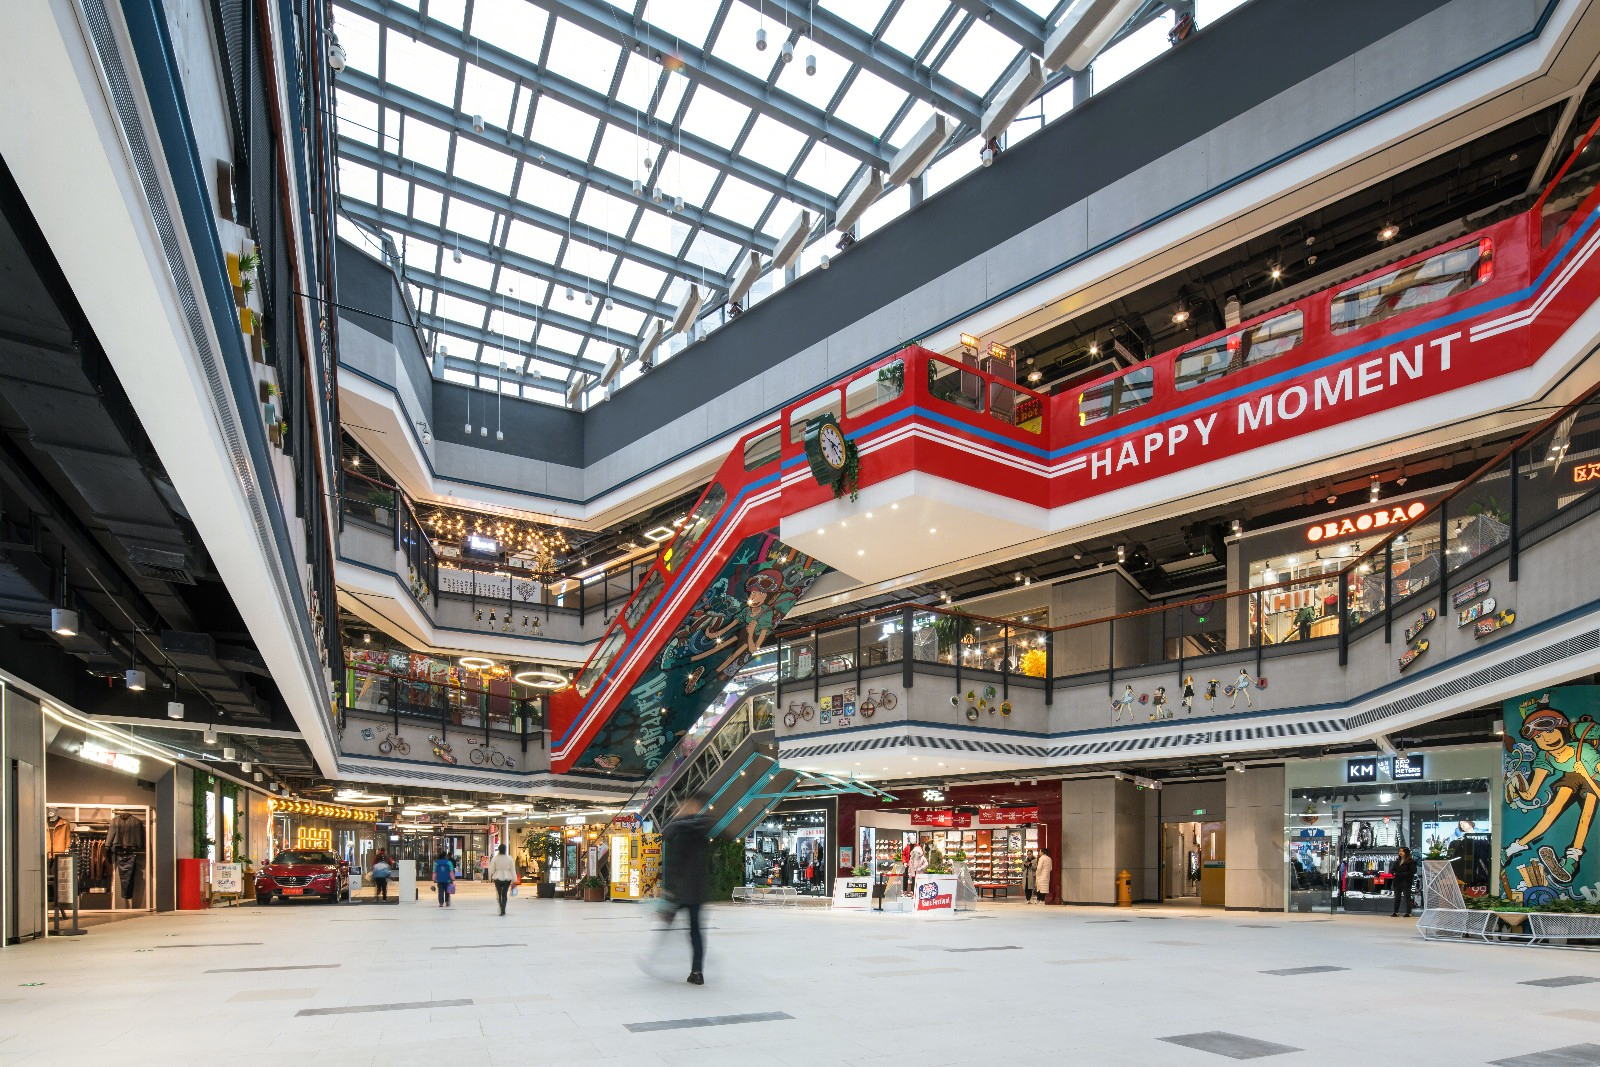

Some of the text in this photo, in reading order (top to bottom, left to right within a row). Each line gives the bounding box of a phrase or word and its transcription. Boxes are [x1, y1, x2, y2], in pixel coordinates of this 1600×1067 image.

[1089, 331, 1463, 481] HAPPY MOMENT
[1307, 502, 1425, 542] OBAOBAO
[1350, 764, 1374, 777] KM
